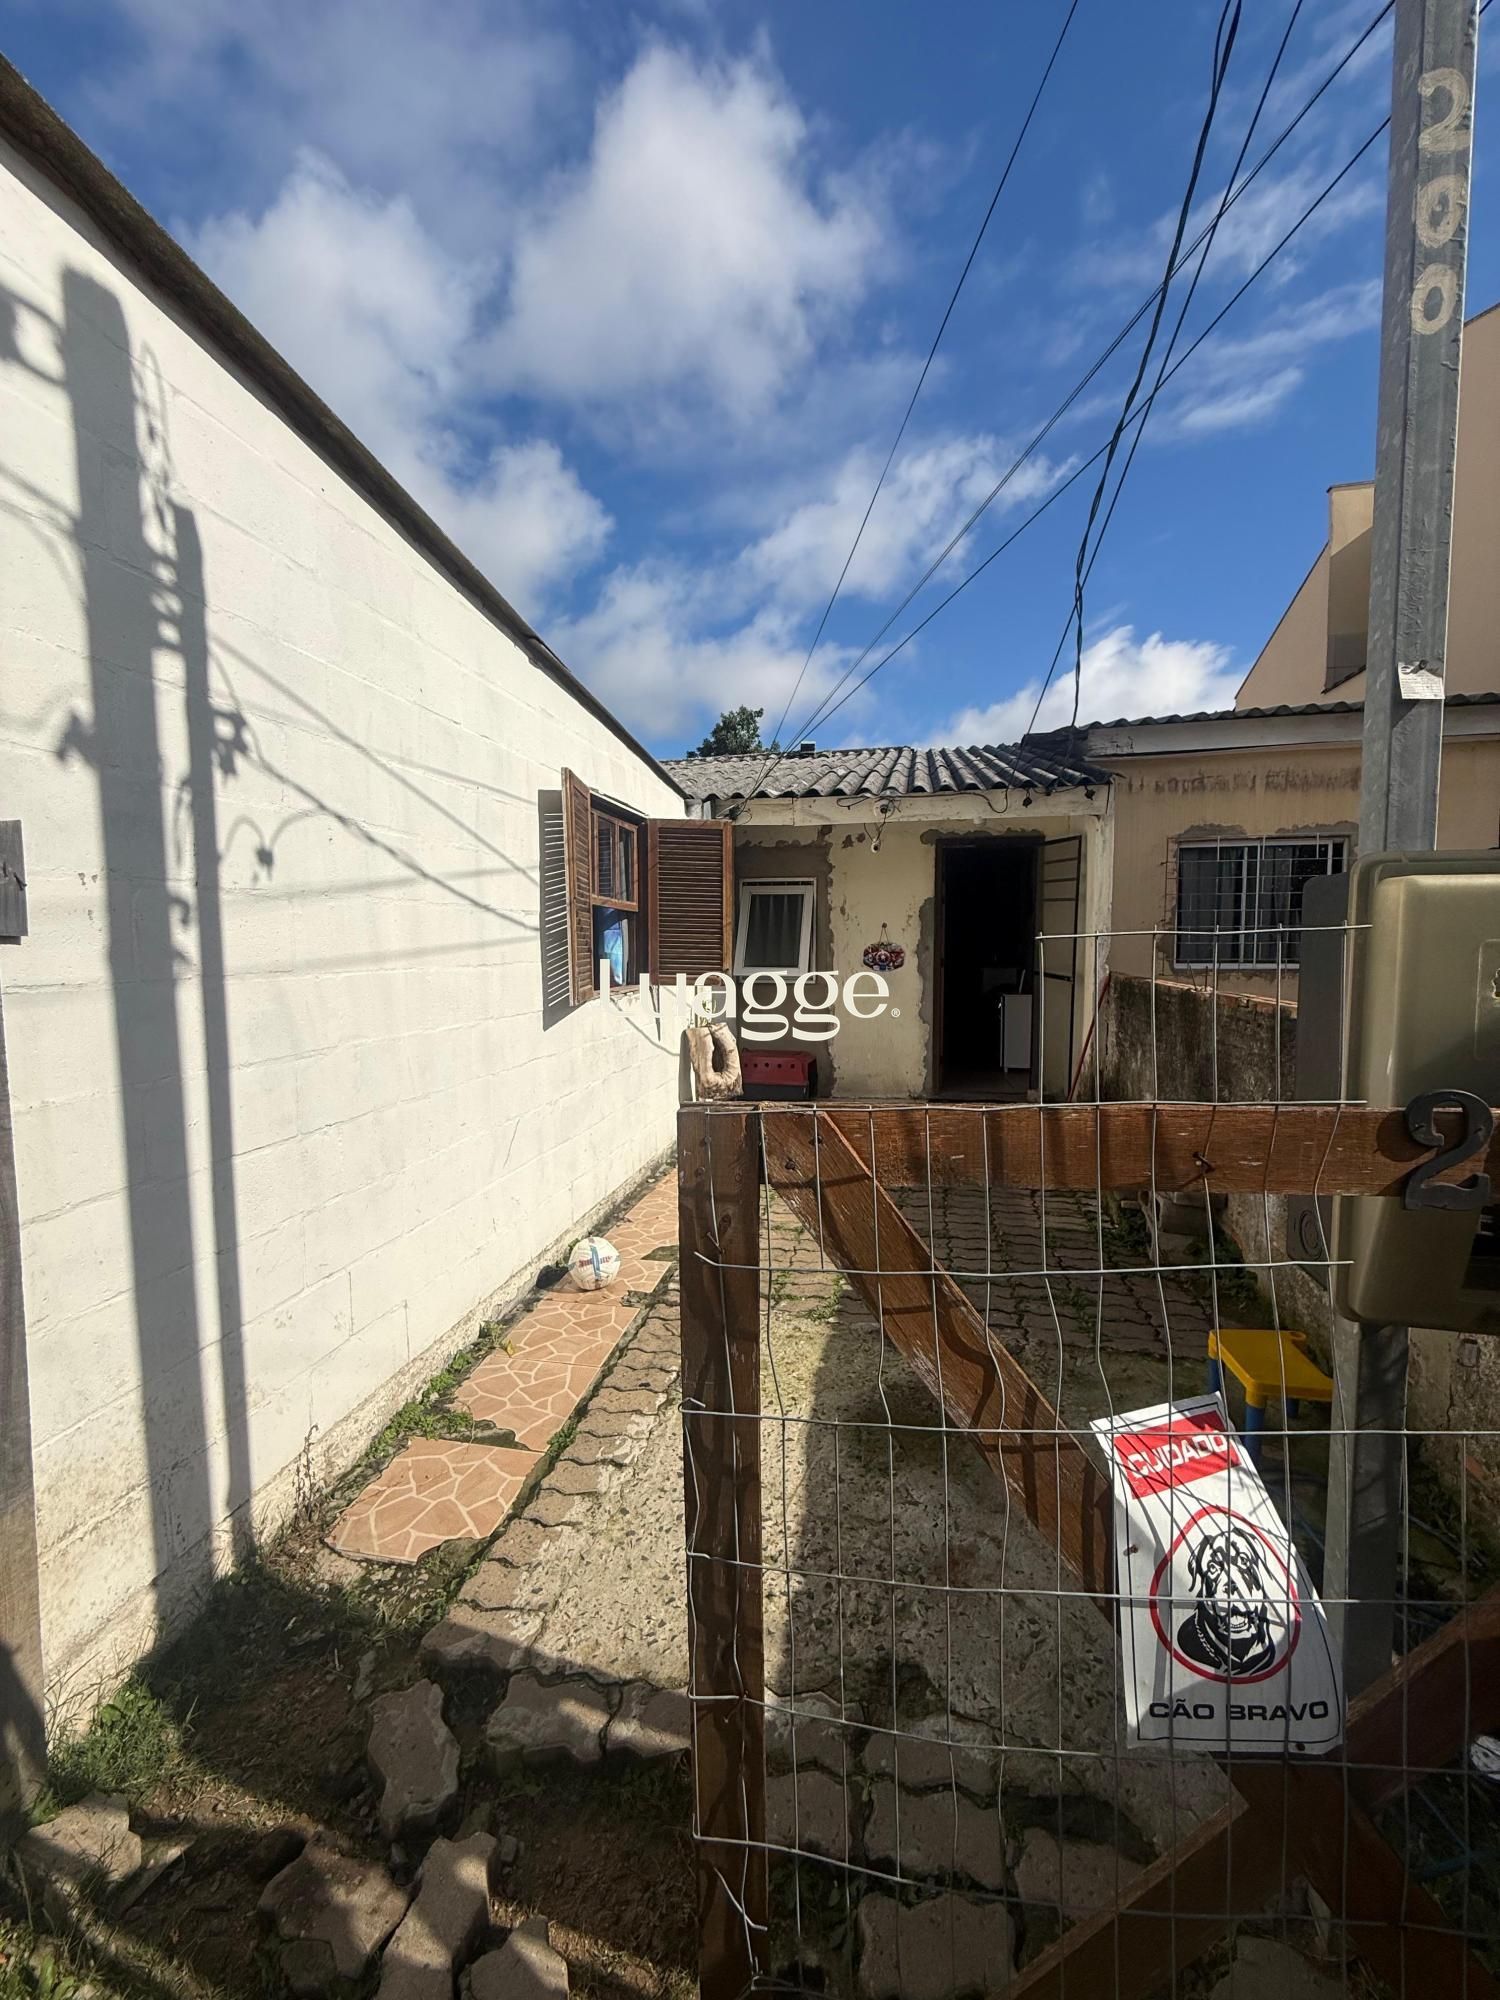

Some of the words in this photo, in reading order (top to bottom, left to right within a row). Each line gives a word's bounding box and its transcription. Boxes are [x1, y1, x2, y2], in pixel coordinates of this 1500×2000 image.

[1410, 66, 1471, 335] 200
[1405, 1089, 1494, 1210] 2
[1128, 1431, 1227, 1478] CUIDADO
[1150, 1699, 1214, 1720] CÃO
[1226, 1701, 1329, 1721] BRAVO
